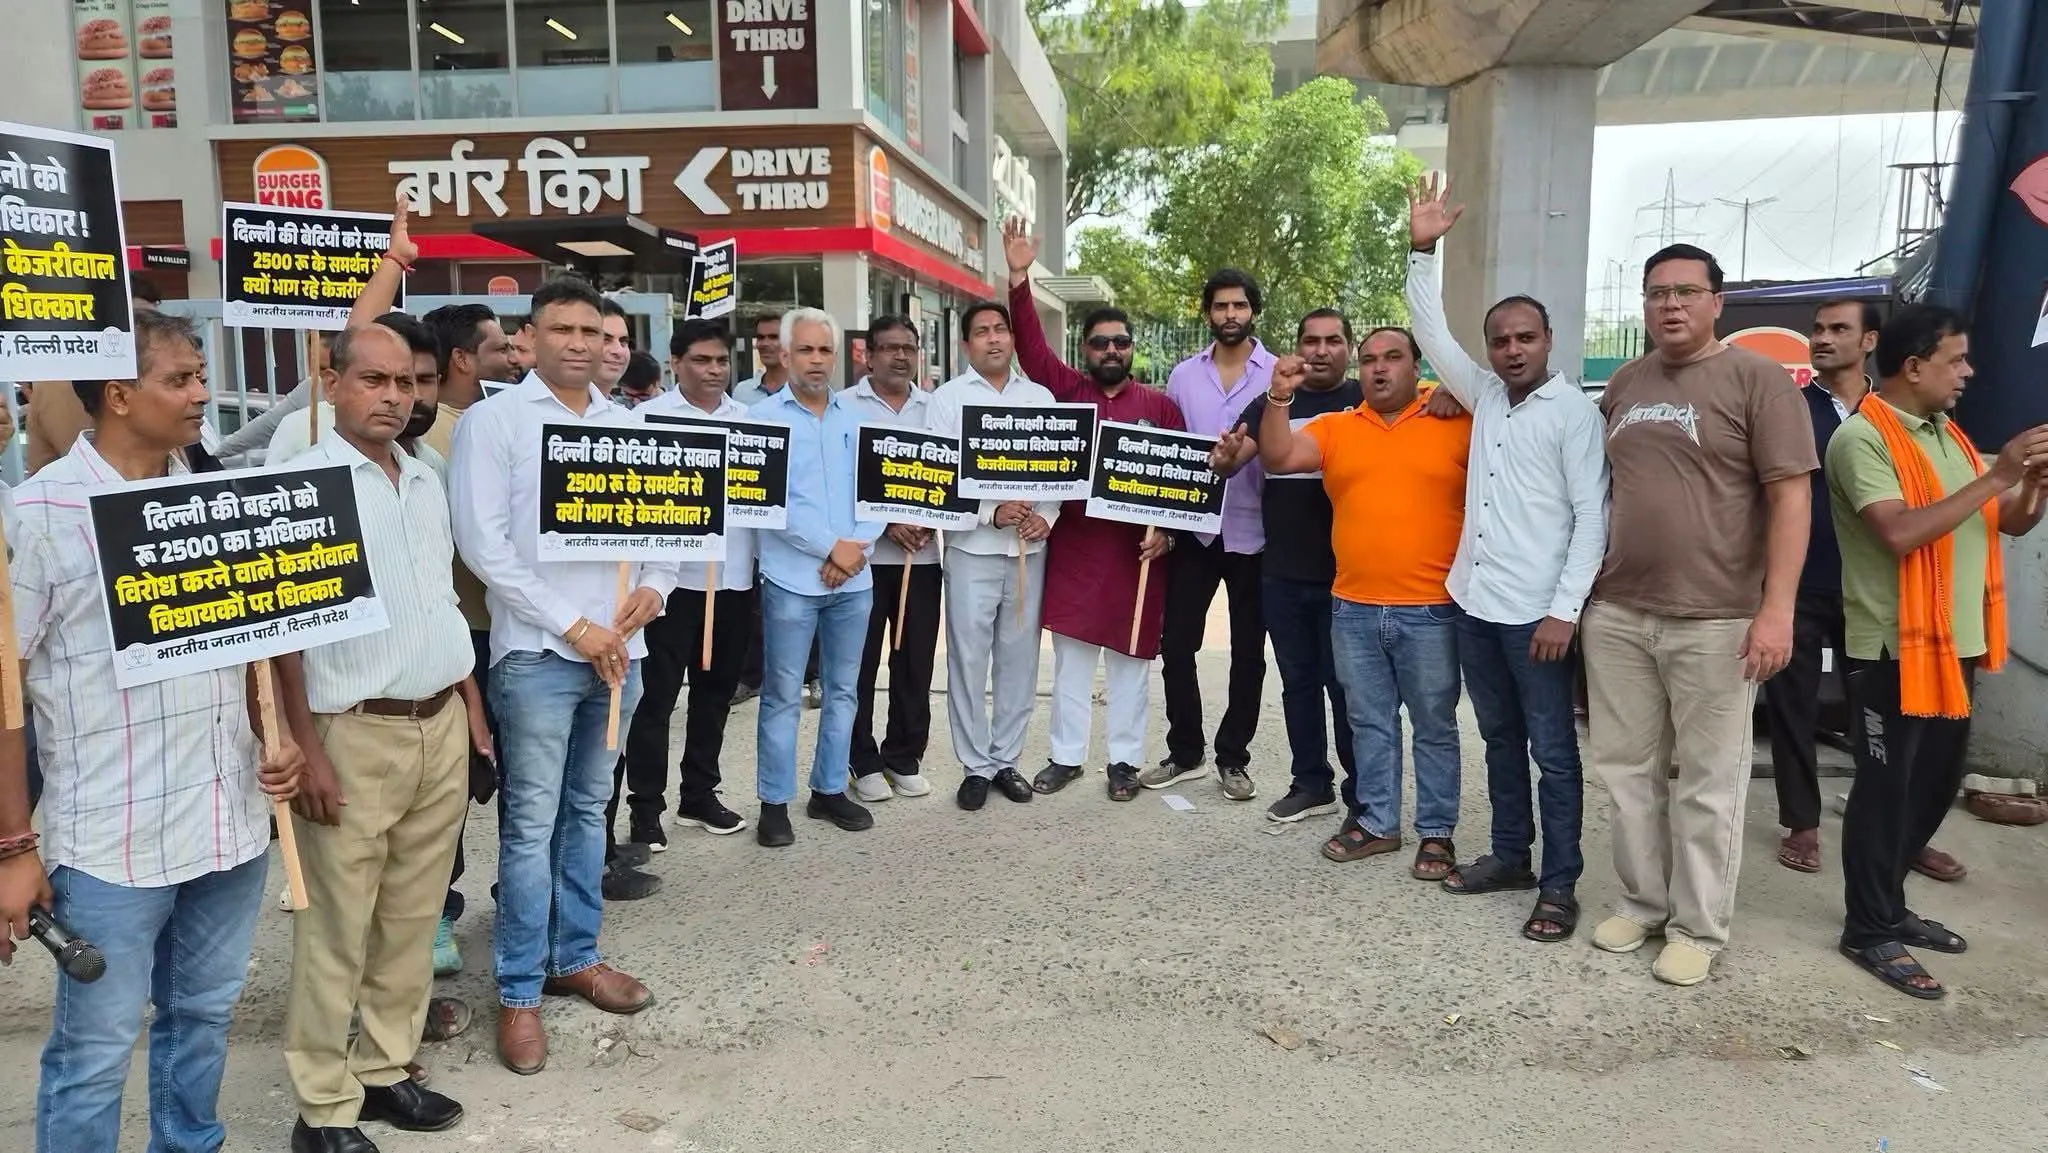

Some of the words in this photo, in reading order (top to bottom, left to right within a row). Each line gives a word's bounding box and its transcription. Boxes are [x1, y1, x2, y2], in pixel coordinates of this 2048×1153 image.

[726, 0, 808, 23] DRIVE
[730, 28, 805, 51] THRU
[0, 151, 27, 190] नो
[31, 156, 66, 194] को
[731, 147, 832, 177] DRIVE
[257, 173, 321, 189] BURGER
[388, 138, 509, 217] बर्गर
[518, 137, 650, 215] किंग
[258, 190, 323, 209] KING
[736, 181, 829, 210] THRU
[232, 218, 276, 243] दिल्ली
[278, 222, 298, 245] की
[301, 222, 339, 248] बेटियाँ
[342, 225, 362, 250] करे
[4, 238, 115, 280] केजरीवाल
[253, 251, 292, 270] 2500
[311, 250, 327, 273] के
[328, 252, 370, 274] समर्थन
[242, 272, 271, 295] क्यों
[272, 278, 300, 296] भाग
[302, 275, 319, 300] रहे
[1, 283, 95, 321] धिक्कार
[252, 306, 286, 316] भारतीय
[288, 308, 314, 317] जनता
[14, 336, 61, 355] दिल्ली
[65, 336, 98, 354] प्रदेश
[981, 414, 1013, 432] दिल्ली
[1015, 415, 1044, 432] लक्ष्मी
[1045, 415, 1077, 431] योजना
[548, 434, 590, 464] दिल्ली
[592, 437, 613, 465] की
[615, 437, 658, 466] बेटियाँ
[658, 440, 684, 468] करे
[684, 447, 721, 469] सवाल
[729, 429, 767, 448] योजना
[767, 437, 784, 450] का
[872, 436, 918, 459] महिला
[920, 439, 959, 464] विरोध
[981, 438, 1010, 451] 2500
[1012, 439, 1028, 451] का
[1029, 436, 1059, 451] विरोध
[1118, 436, 1150, 455] दिल्ली
[1149, 443, 1178, 459] लक्ष्मी
[1179, 445, 1210, 463] योजन
[741, 449, 766, 466] वाले
[976, 455, 1028, 473] केजरीवाल
[1028, 458, 1058, 473] जवाब
[1115, 460, 1144, 475] 2500
[1145, 464, 1161, 477] का
[1161, 463, 1192, 481] विरोध
[566, 472, 606, 493] 2500
[626, 468, 642, 494] के
[644, 469, 690, 496] समर्थन
[690, 471, 704, 497] से
[881, 458, 954, 486] केजरीवाल
[884, 483, 927, 502] जवाब
[928, 486, 946, 506] दो
[1108, 476, 1158, 497] केजरीवाल
[1159, 487, 1187, 501] जवाब
[142, 495, 206, 531] दिल्ली
[208, 491, 240, 521] की
[241, 485, 291, 518] बहनो
[289, 481, 318, 508] को
[555, 497, 584, 523] क्यों
[585, 502, 613, 524] भाग
[615, 498, 635, 527] रहे
[161, 534, 218, 564] 2500
[220, 530, 251, 553] का
[564, 536, 599, 547] भारतीय
[600, 537, 628, 548] जनता
[655, 537, 681, 548] दिल्ली
[682, 538, 702, 549] प्रदेश
[115, 572, 177, 606] विरोध
[179, 560, 231, 594] करने
[233, 553, 274, 581] वाले
[276, 542, 358, 574] केजरीवाल
[149, 590, 246, 635] विधायकों
[246, 592, 275, 614] पर
[276, 577, 343, 609] धिक्कार
[157, 640, 208, 661] भारतीय
[211, 633, 251, 650] जनता
[287, 615, 321, 634] दिल्ली
[322, 610, 349, 627] प्रदेश
[1863, 706, 1887, 765] NIKE
